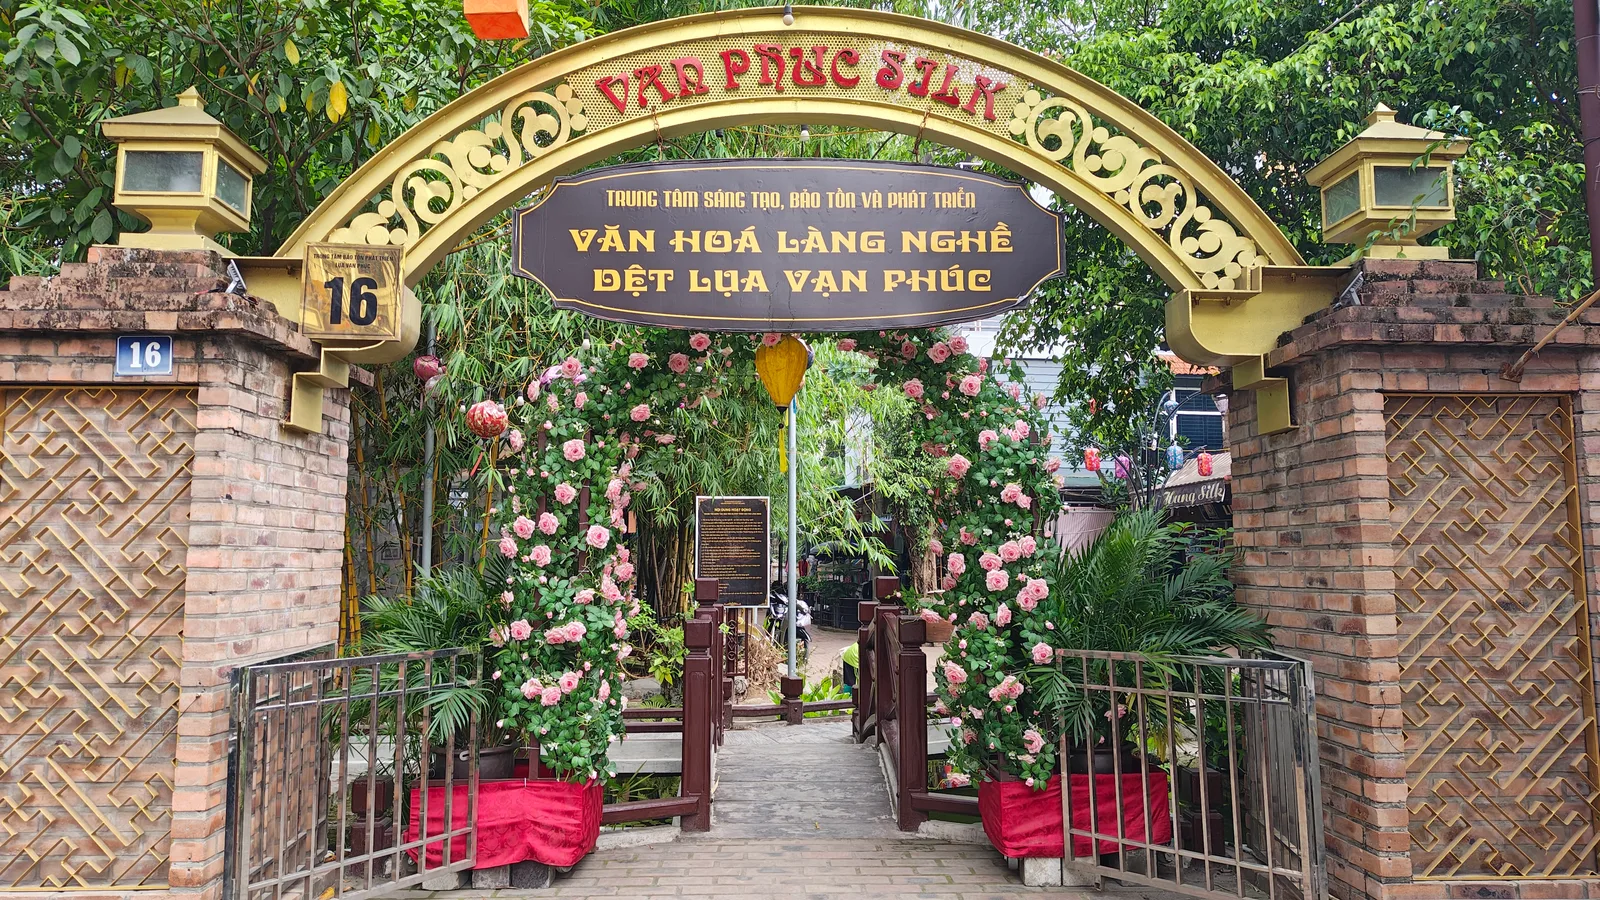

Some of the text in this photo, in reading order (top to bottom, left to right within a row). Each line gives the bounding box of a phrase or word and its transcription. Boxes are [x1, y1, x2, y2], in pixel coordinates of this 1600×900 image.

[595, 43, 1006, 121] VAN PHUC SILK
[606, 186, 977, 211] TRUNG TÂM SÁNG TẠO, BẢO TỒN VÀ PHÁT TRIỂN
[568, 221, 1014, 254] VĂN HOÁ LÀNG NGHỀ
[592, 263, 992, 298] DỆT LỤA VẠN PHÚC
[324, 277, 378, 326] 16
[130, 341, 162, 368] 16
[1198, 483, 1226, 502] Silk
